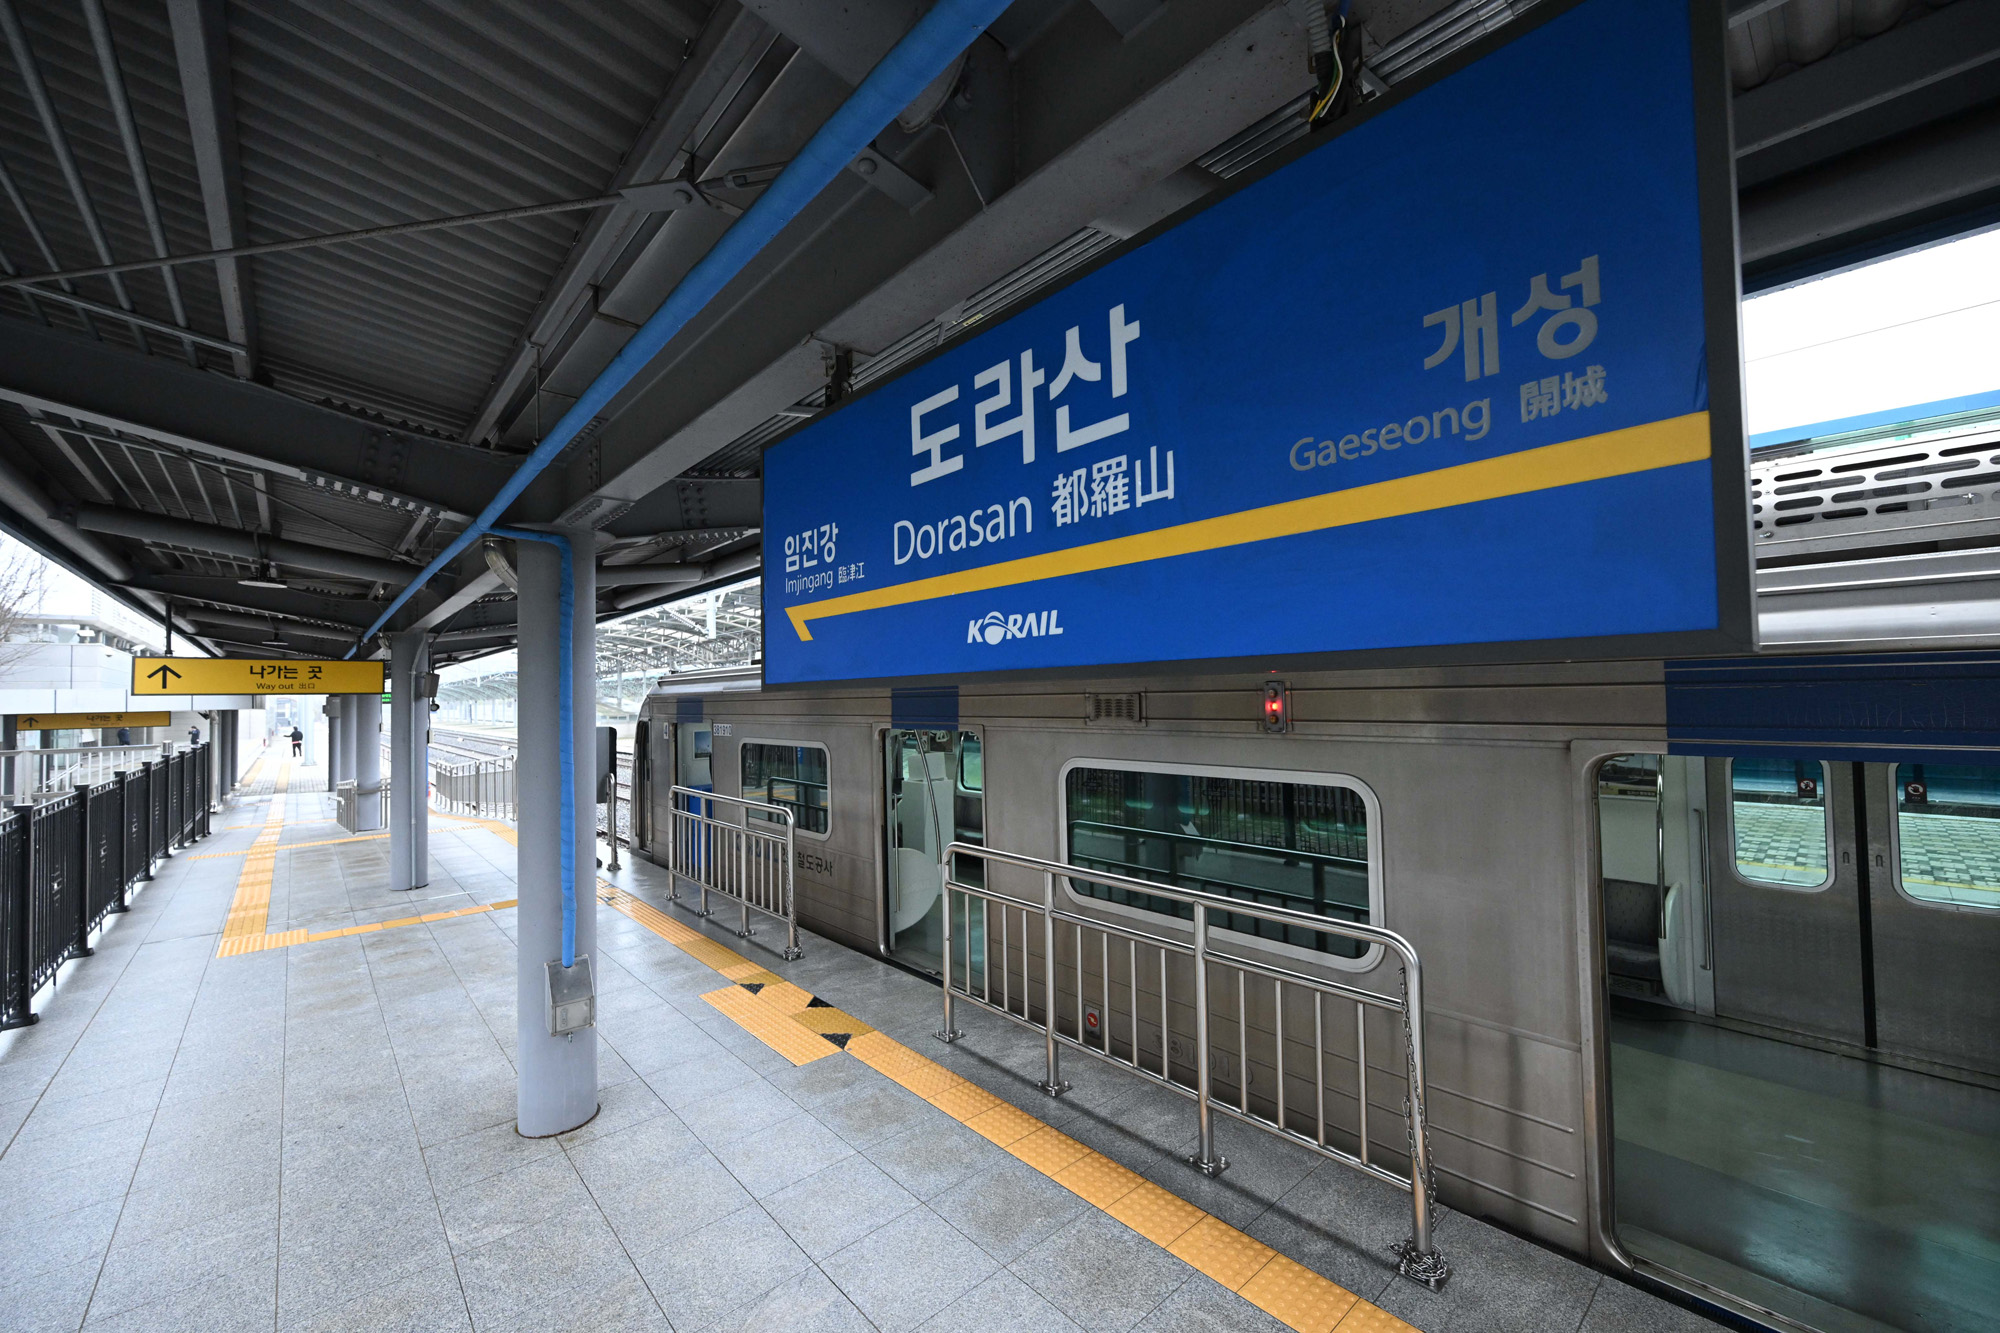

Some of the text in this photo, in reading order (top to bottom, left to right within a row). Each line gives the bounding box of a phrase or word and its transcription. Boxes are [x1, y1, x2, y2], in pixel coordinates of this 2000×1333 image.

[1423, 254, 1600, 382] 개성
[911, 303, 1140, 487] 도라산
[1289, 365, 1608, 472] Gaeseong 開城
[893, 445, 1174, 565] Dorasan 都羅山
[784, 522, 839, 573] 임진강
[785, 562, 865, 595] Imjingang 臨津江
[967, 609, 1064, 645] KORAIL
[249, 665, 323, 680] 나가는 곳
[256, 682, 276, 691] Way
[299, 682, 316, 690] 出口
